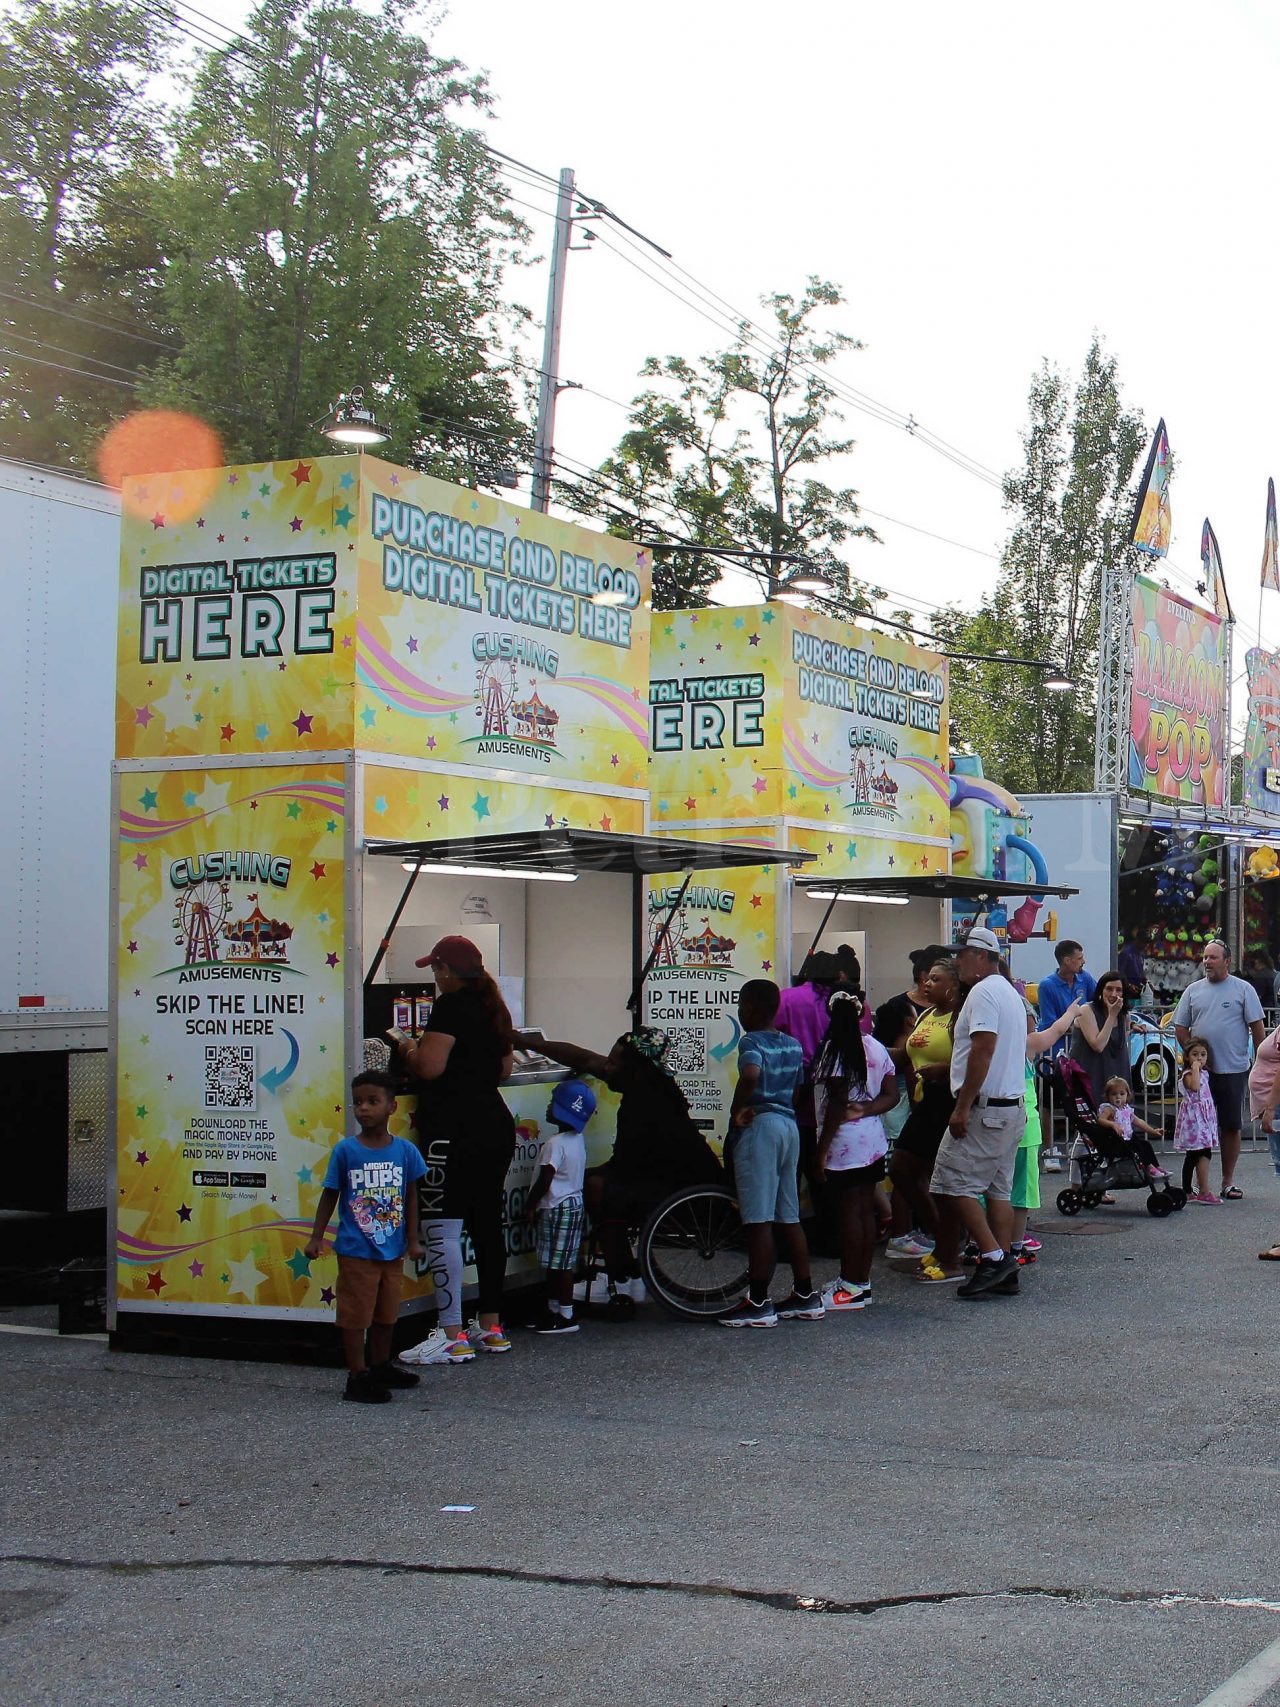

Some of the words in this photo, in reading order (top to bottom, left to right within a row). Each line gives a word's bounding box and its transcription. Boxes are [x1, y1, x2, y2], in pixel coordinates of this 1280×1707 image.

[372, 492, 505, 574] PURCHASE
[508, 536, 557, 586] AND
[559, 550, 640, 610] RELOAD
[141, 561, 234, 598] DIGITAL
[234, 553, 336, 592] TICKETS
[383, 544, 482, 613] DIGITAL
[484, 572, 575, 634] TICKETS
[577, 598, 632, 649] HERE
[140, 588, 335, 664] HERE
[472, 632, 559, 679] CUSHING
[793, 629, 866, 682] PURCHASE
[868, 654, 896, 690] AND
[898, 663, 945, 704] RELOAD
[683, 673, 764, 702] TICKETS
[1136, 631, 1224, 723] BALLOON
[799, 667, 854, 712] DIGITAL
[855, 682, 907, 726] TICKETS
[908, 699, 940, 734] HERE
[653, 699, 764, 752] ERE
[477, 741, 551, 763] AMUSEMENTS
[848, 726, 898, 759] CUSHING
[1145, 709, 1212, 786] POP
[852, 807, 895, 822] AMUSEMENTS
[170, 851, 292, 889] CUSHING
[649, 886, 735, 913] USHING
[178, 967, 281, 984] AMUSEMENTS
[156, 995, 200, 1014] SKIP
[207, 995, 245, 1014] THE
[253, 995, 304, 1014] LINE!
[668, 991, 699, 1004] THE
[705, 991, 740, 1005] LINE
[186, 1019, 227, 1035] SCAN
[232, 1020, 274, 1035] HERE
[651, 1008, 684, 1019] SCAN
[689, 1009, 721, 1020] HERE
[683, 1089, 704, 1097] ONEY
[706, 1089, 721, 1097] APP
[701, 1080, 716, 1088] THE
[184, 1130, 214, 1140] MAGIC
[217, 1131, 252, 1141] MONEY
[255, 1132, 275, 1141] APP
[191, 1118, 246, 1129] DOWNLOAD
[249, 1119, 268, 1129] THE
[183, 1149, 202, 1159] AND
[205, 1150, 224, 1159] PAY
[227, 1150, 240, 1160] BY
[243, 1151, 277, 1161] PHONE
[363, 1161, 393, 1170] MIGHTY
[348, 1166, 403, 1189] PUPS
[420, 1139, 450, 1212] Klein
[425, 1223, 453, 1311] Calvin
